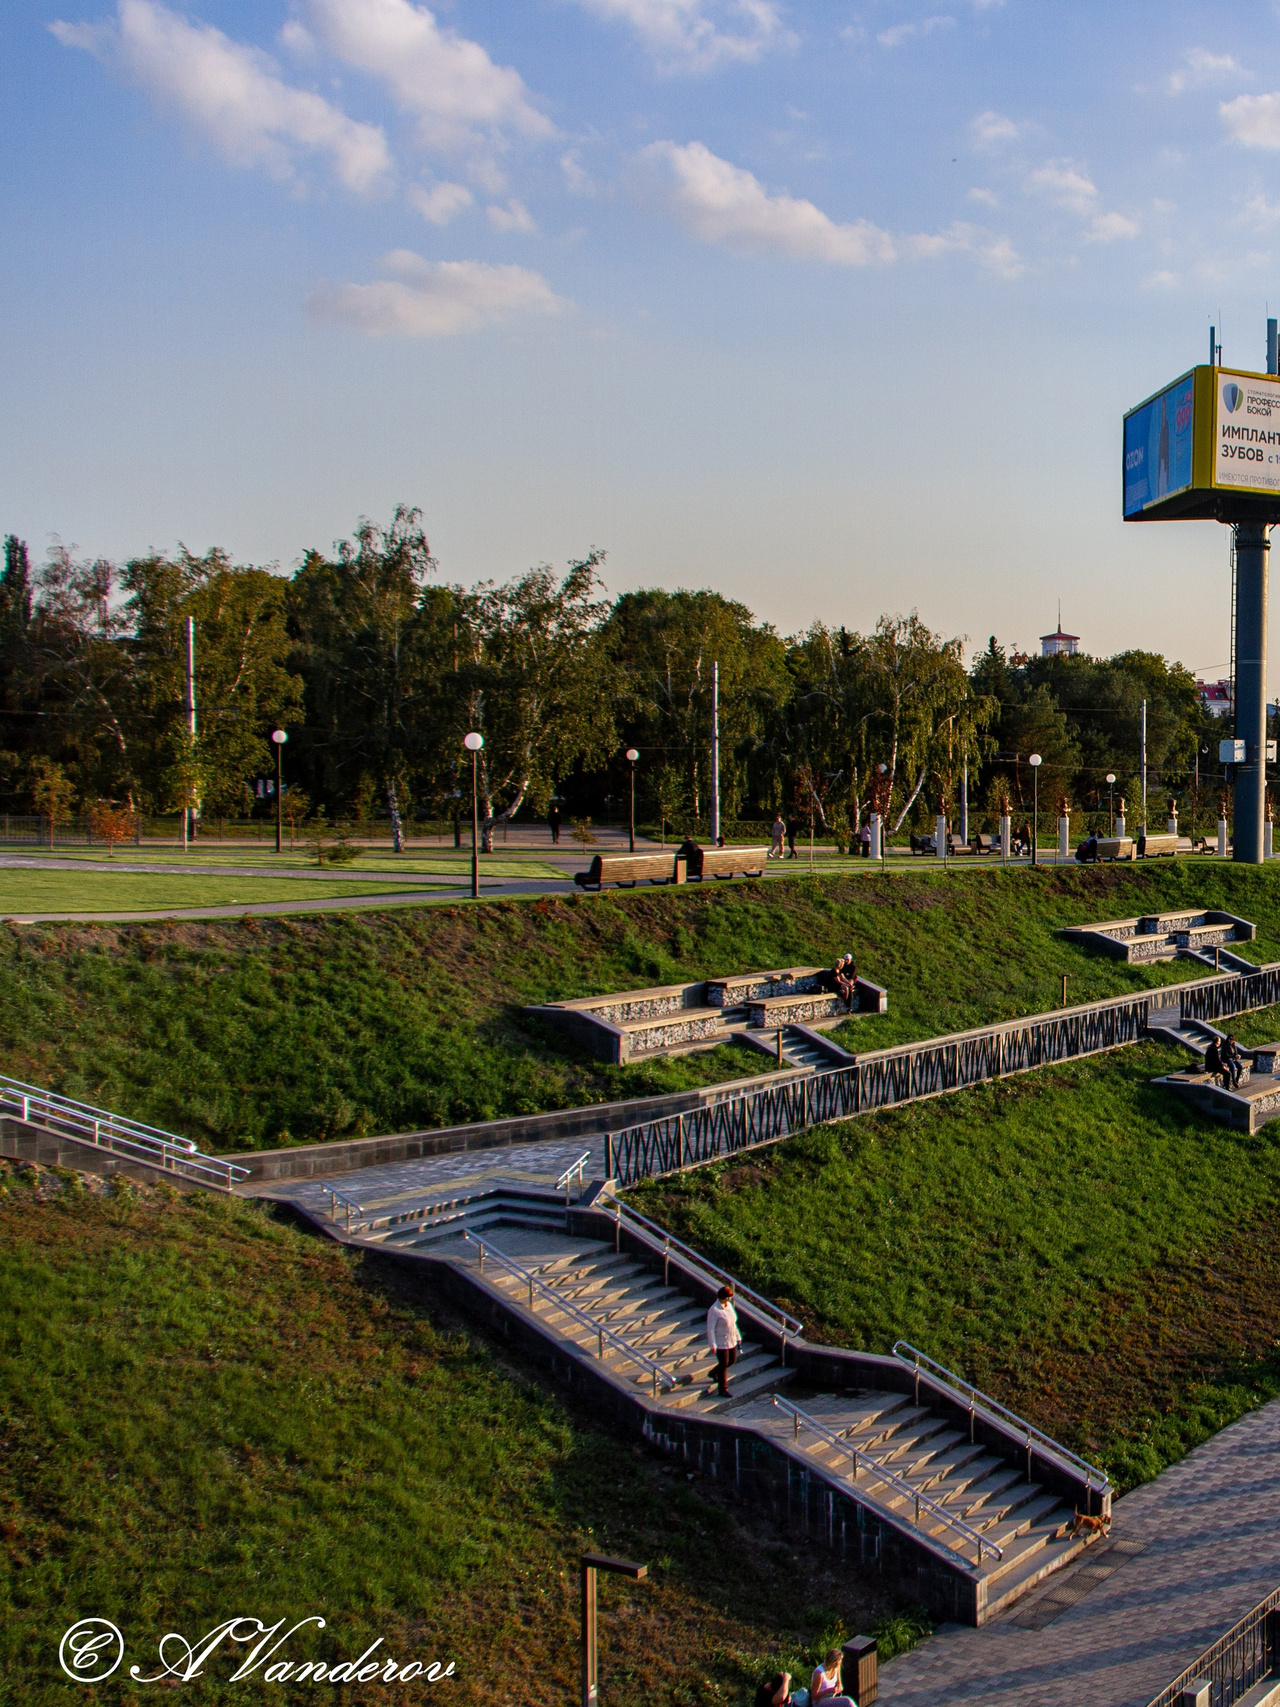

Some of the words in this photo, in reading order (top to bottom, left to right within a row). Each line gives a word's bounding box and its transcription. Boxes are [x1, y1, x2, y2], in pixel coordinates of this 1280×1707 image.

[1247, 406, 1272, 417] БОКОЙ
[1126, 446, 1144, 471] OZON
[1222, 444, 1264, 462] ЗУБОВ
[1268, 455, 1273, 464] с
[1218, 472, 1249, 482] ИМЕЮТСЯ
